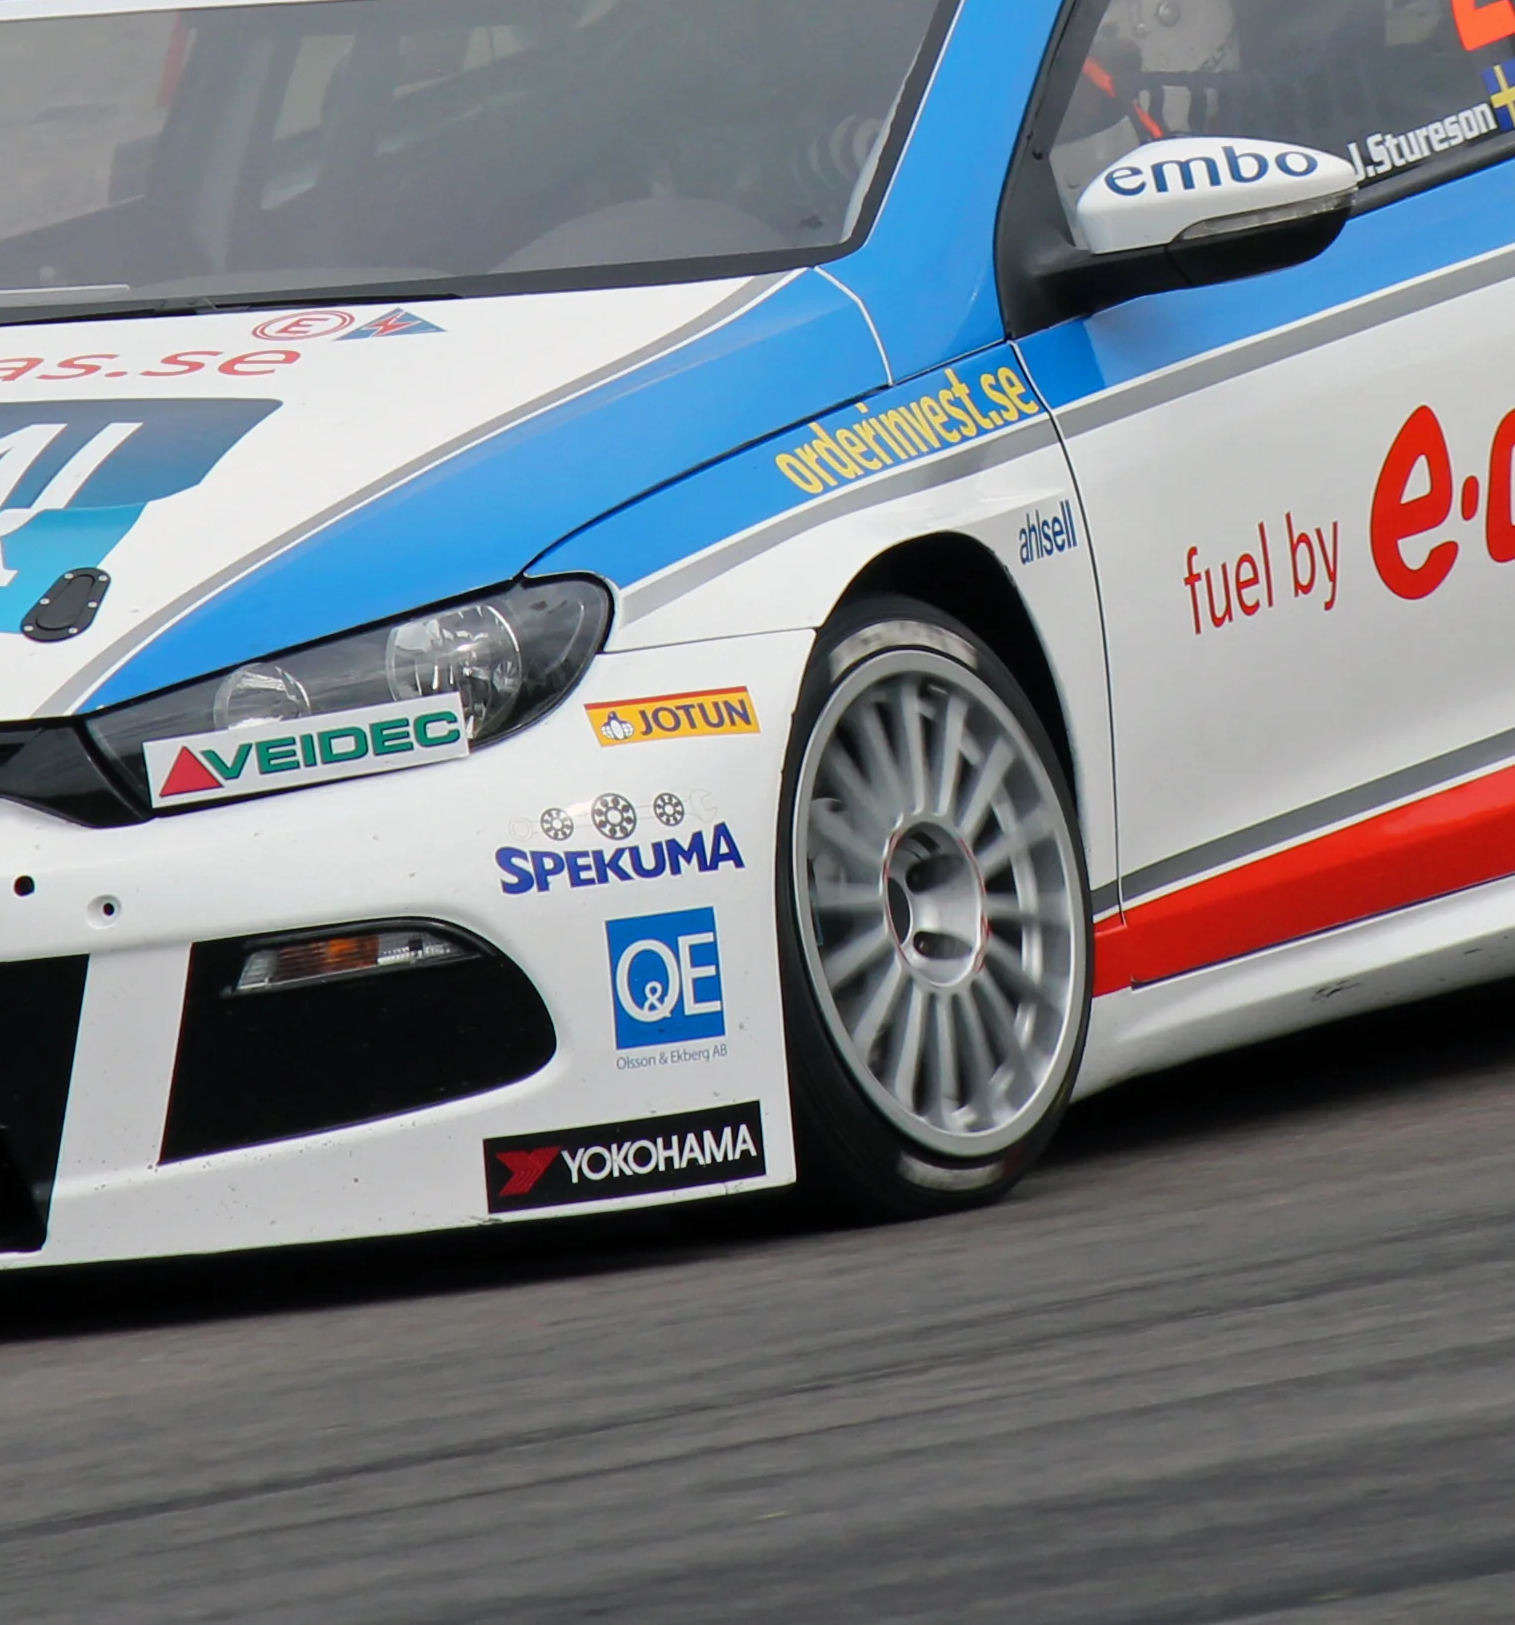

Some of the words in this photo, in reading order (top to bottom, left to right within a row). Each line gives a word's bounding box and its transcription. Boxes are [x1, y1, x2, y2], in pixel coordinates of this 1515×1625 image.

[1104, 145, 1318, 196] embo
[774, 364, 1039, 495] orderinvest.se
[1018, 500, 1077, 566] ahlsell
[1185, 522, 1273, 635] fuel
[1287, 513, 1339, 611] by
[201, 711, 462, 780] VEIDEC
[638, 699, 753, 735] JOTUN
[494, 821, 746, 895] SPEKUMA
[616, 1055, 656, 1070] Olsson
[670, 1048, 710, 1064] Ekberg
[712, 1043, 728, 1057] AB
[560, 1123, 757, 1184] YOKOHAMA
